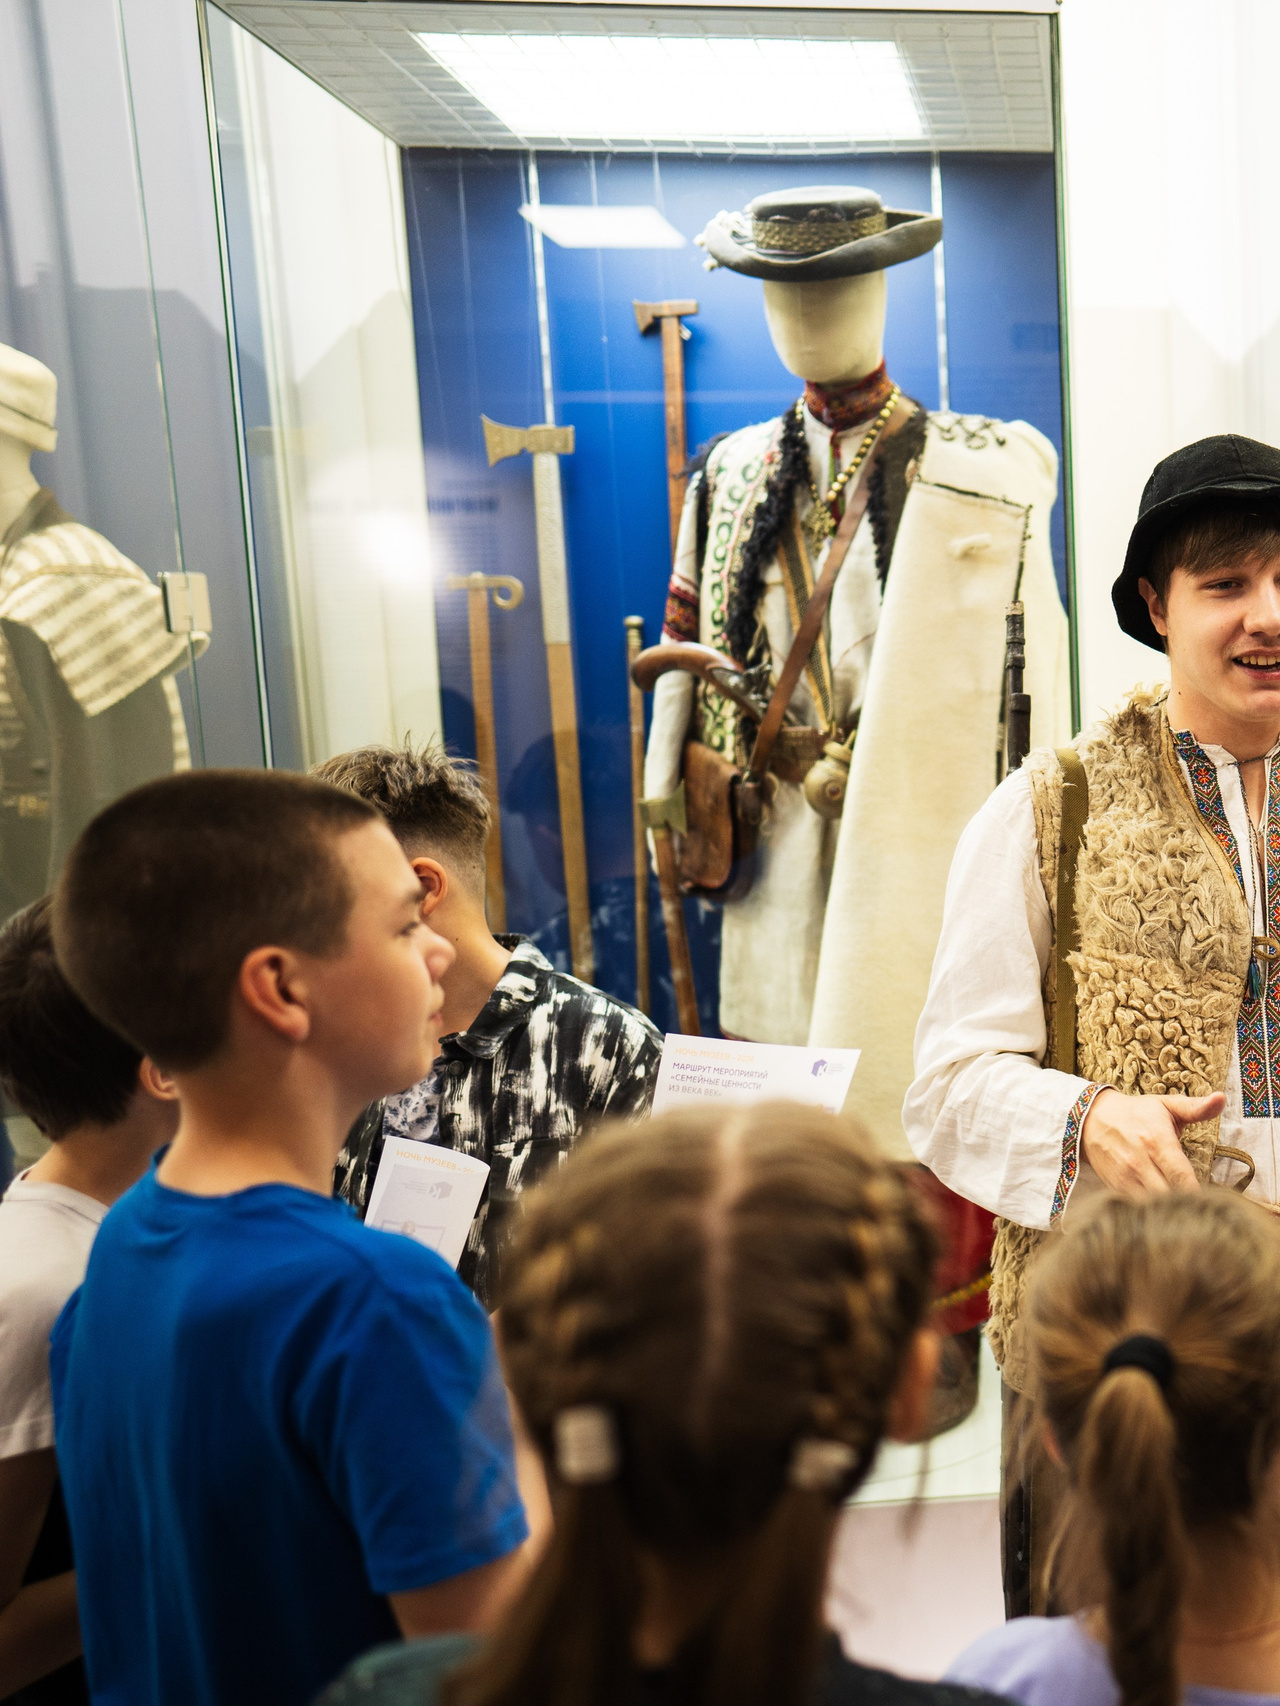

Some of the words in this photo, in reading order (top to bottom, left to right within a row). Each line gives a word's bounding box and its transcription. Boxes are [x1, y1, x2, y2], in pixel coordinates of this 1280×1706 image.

[672, 1062, 712, 1074] МАРШРУТ
[713, 1066, 768, 1080] МЕРОПРИЯТИЙ
[668, 1084, 680, 1092] ИЗ
[682, 1086, 702, 1094] ВЕКА
[670, 1074, 720, 1086] «СЕМЕЙНЫЕ
[722, 1080, 762, 1090] ЦЕННОСТИ
[396, 1150, 422, 1160] НОЧЬ
[424, 1156, 457, 1170] МУЗЕЕВ
